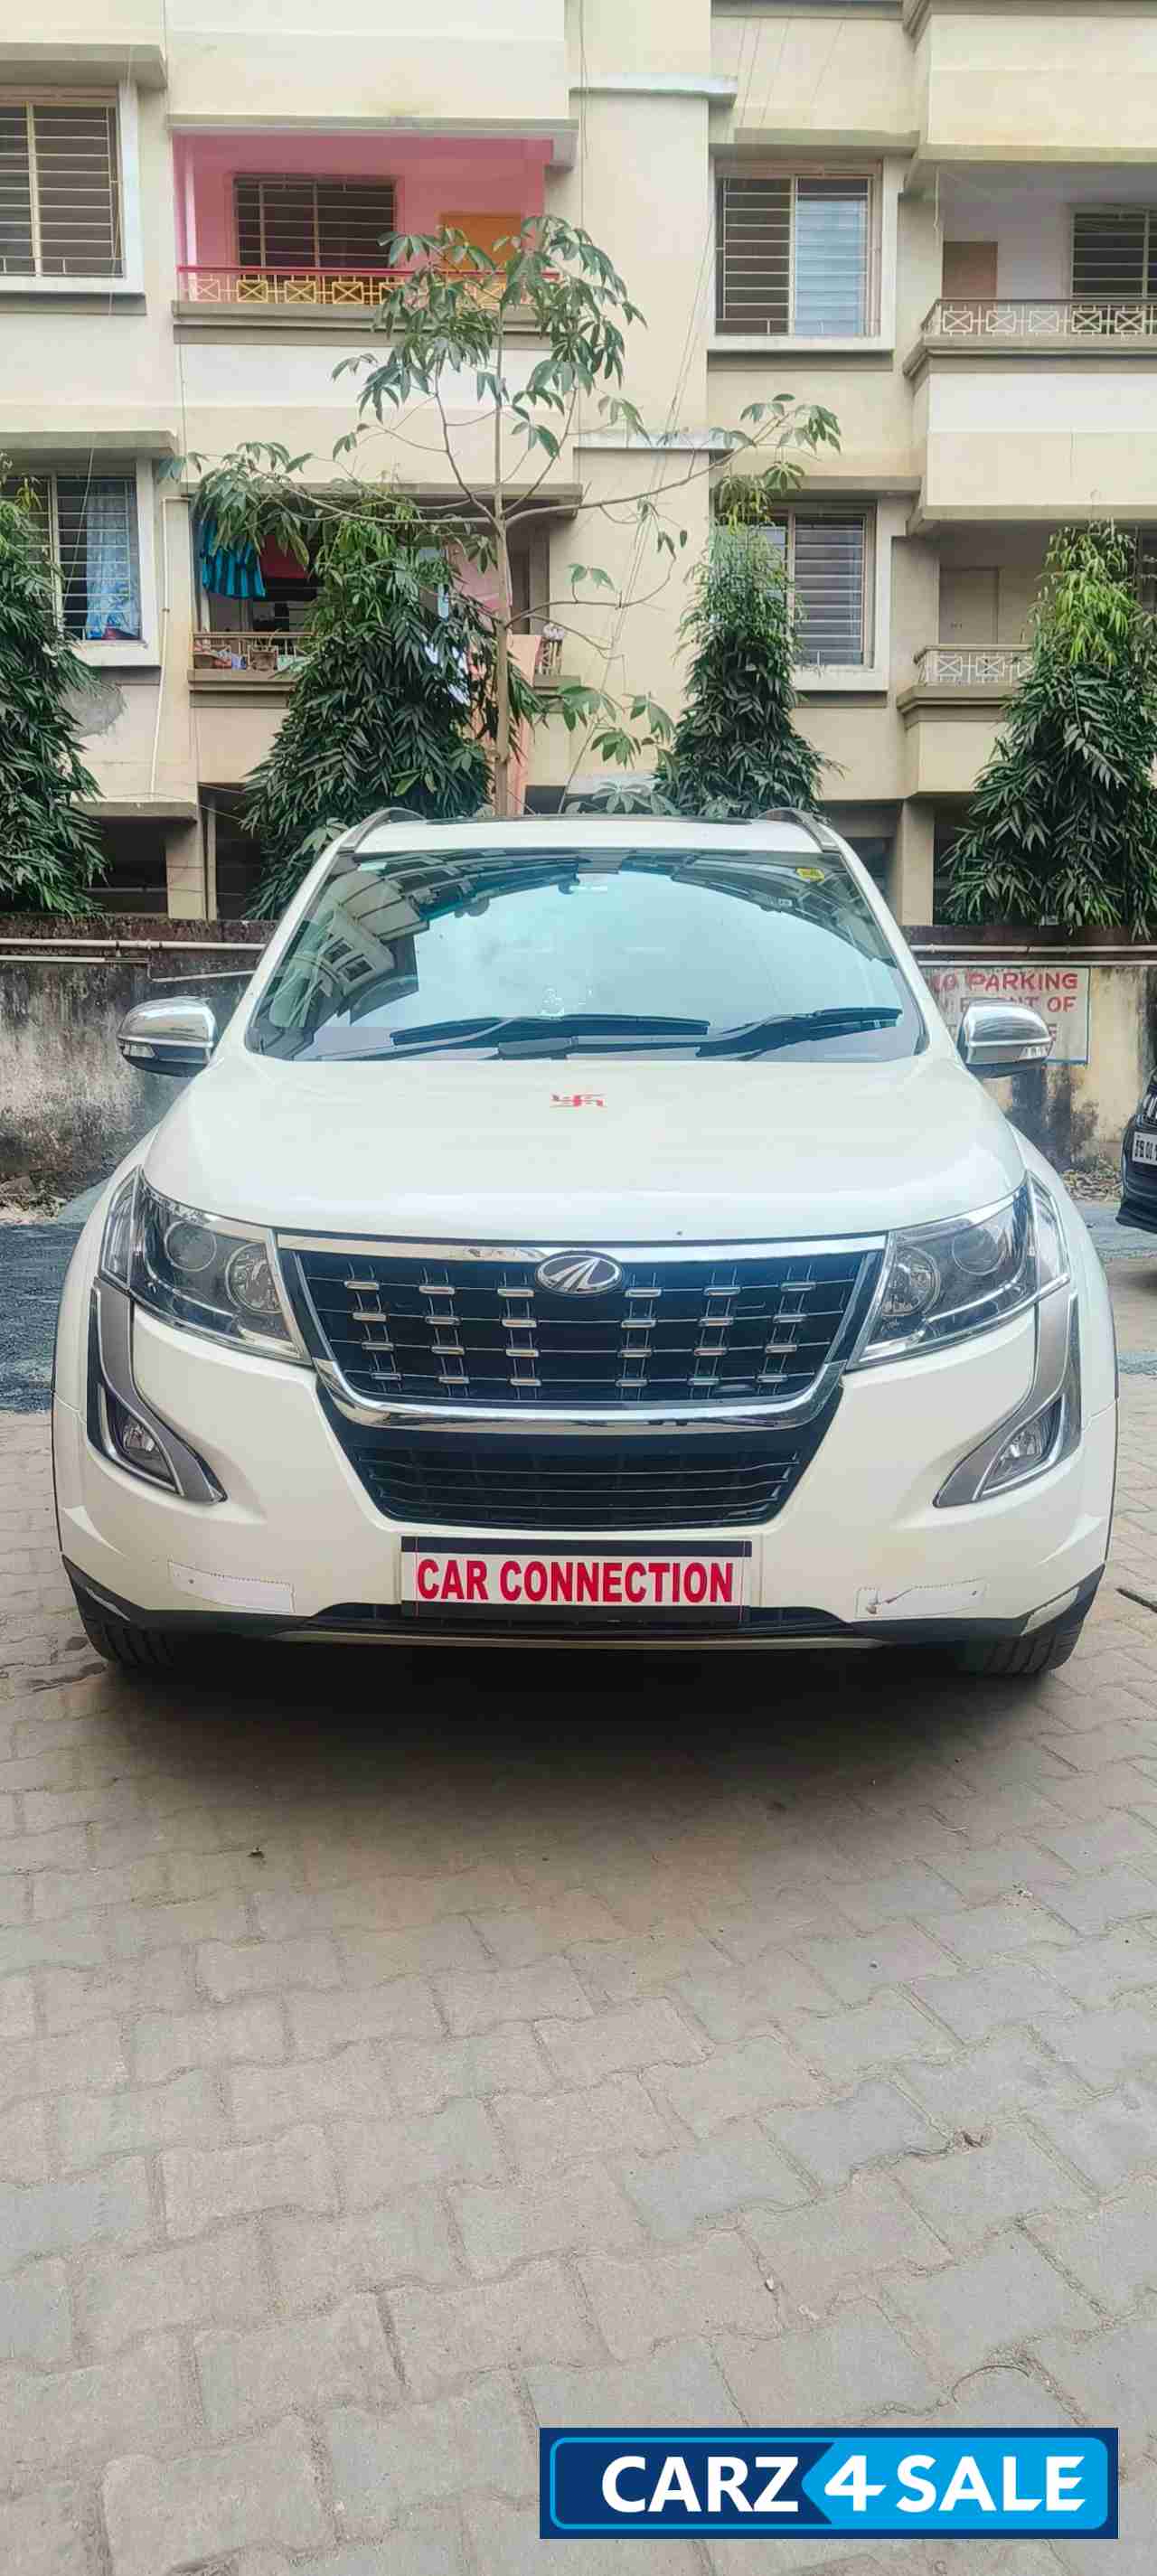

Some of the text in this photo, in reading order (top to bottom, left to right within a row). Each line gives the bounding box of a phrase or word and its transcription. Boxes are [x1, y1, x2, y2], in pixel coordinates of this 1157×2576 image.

[966, 973, 1077, 992] PARKING
[1048, 996, 1077, 1012] OF
[417, 1558, 734, 1603] CAR CONNECTION
